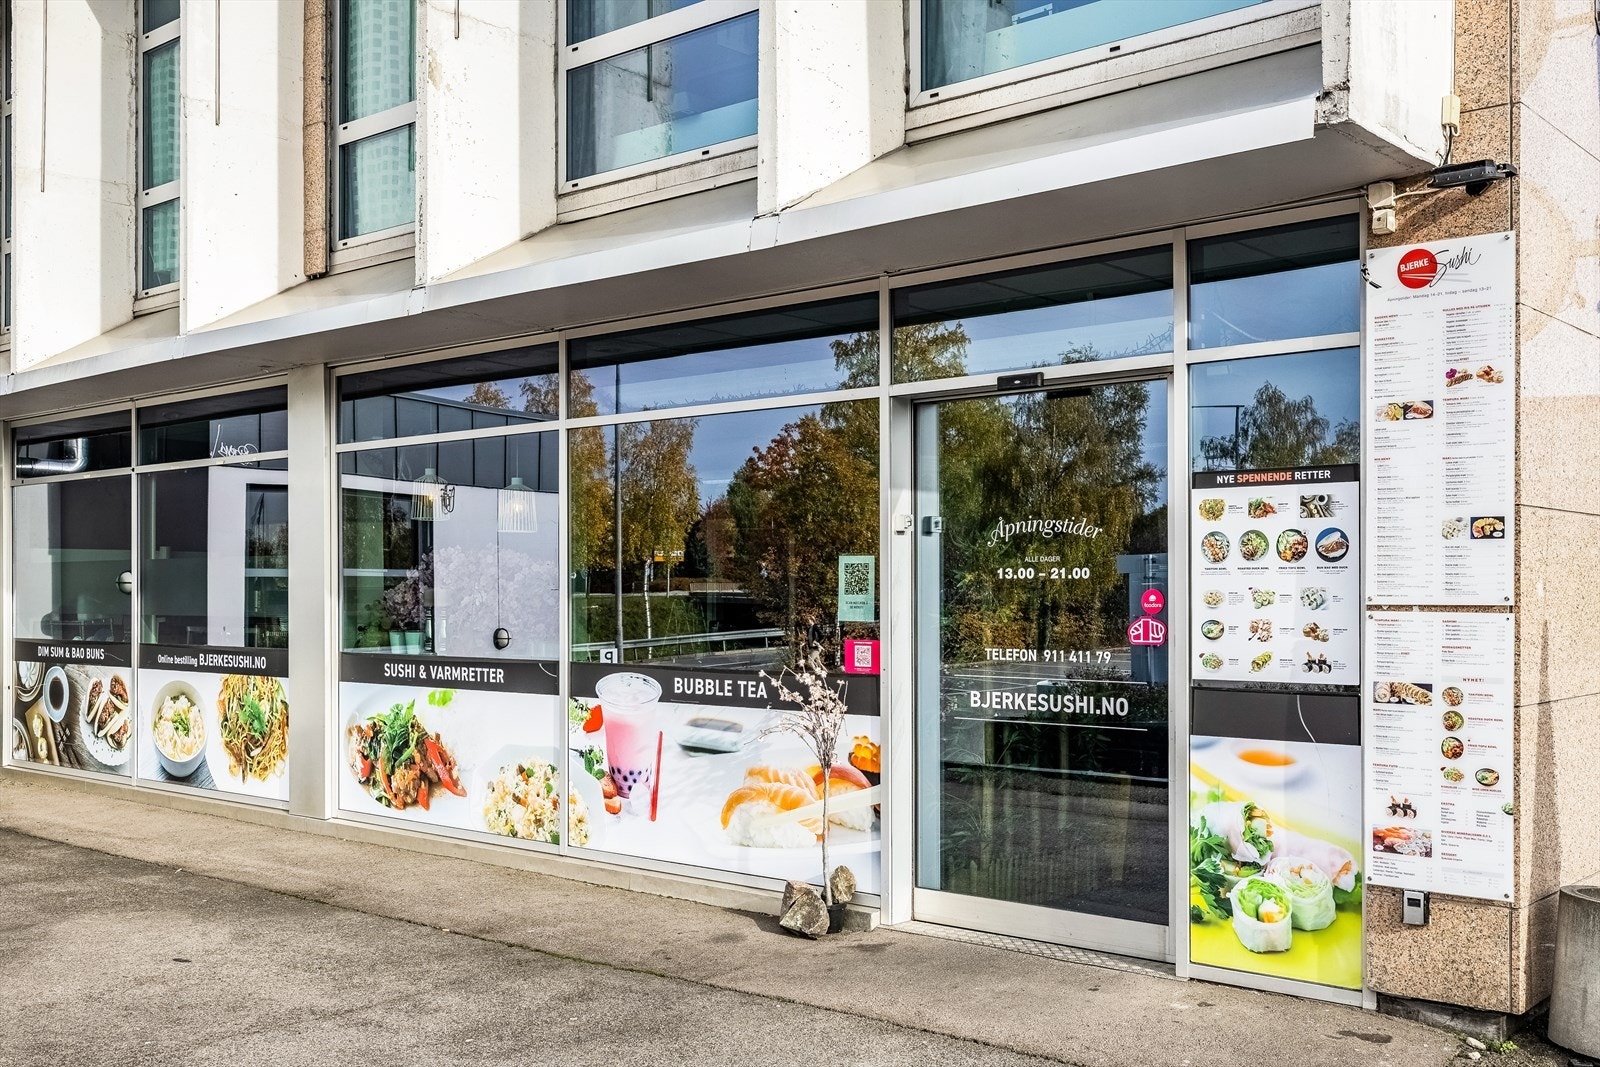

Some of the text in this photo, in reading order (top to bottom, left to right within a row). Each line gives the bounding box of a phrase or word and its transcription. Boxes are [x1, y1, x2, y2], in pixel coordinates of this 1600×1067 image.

[1400, 246, 1482, 288] BJERKE Sushi
[1216, 470, 1331, 484] NYE SPENNENDE RETTER
[987, 515, 1103, 548] Åpningstider
[997, 567, 1035, 580] 13.00
[1050, 567, 1090, 579] 21.00
[38, 645, 105, 660] DIM SUM & BAO BUNS
[157, 653, 267, 669] Online bestilling BJERKESUSHI.NO
[985, 648, 1112, 664] TELEFON 911 411 79
[384, 663, 505, 683] SUSHI & VARMRETTER
[674, 677, 768, 699] BUBBLE TEA
[970, 690, 1130, 717] BJERKESUSHI.NO
